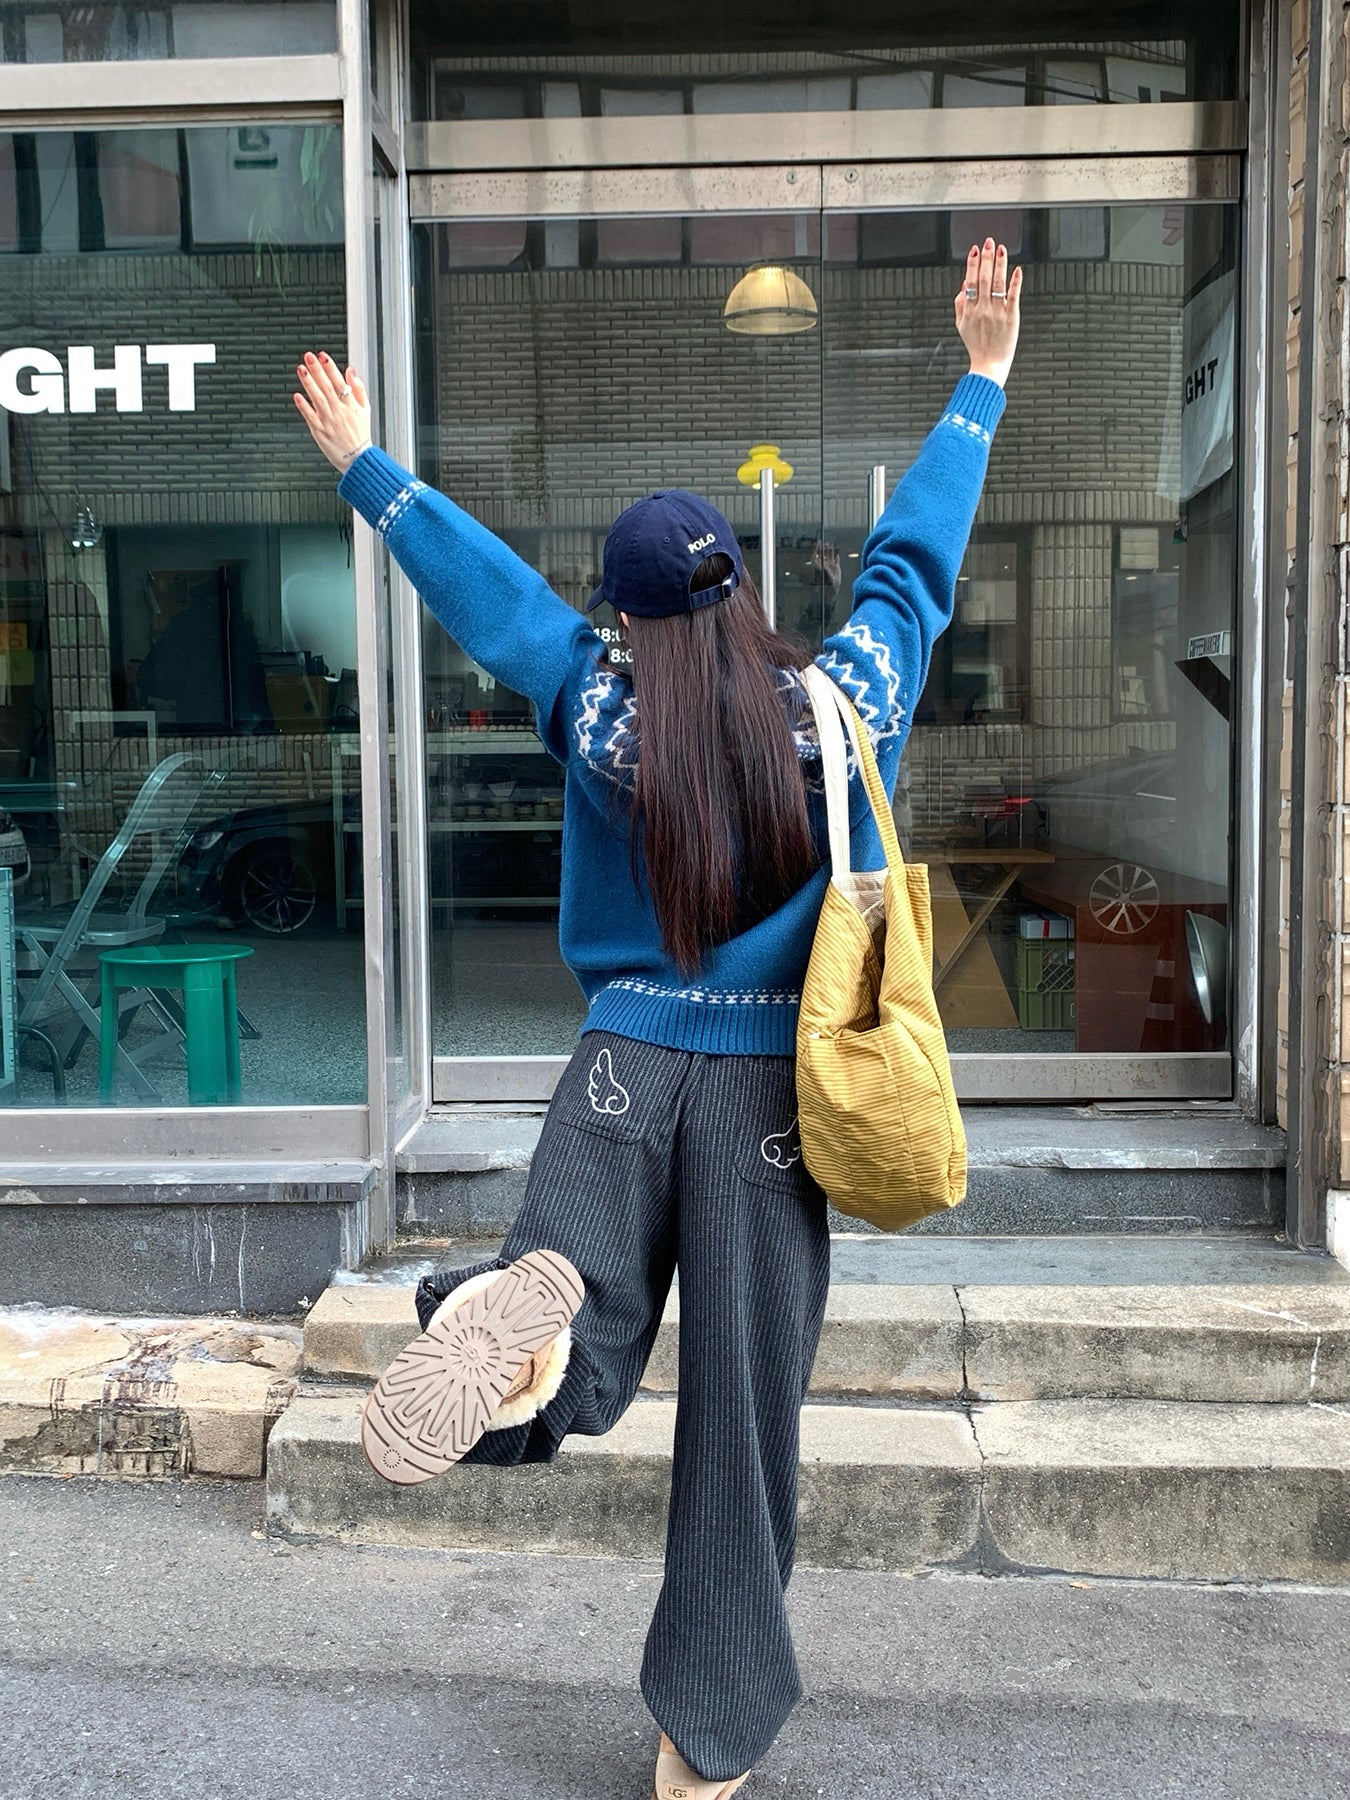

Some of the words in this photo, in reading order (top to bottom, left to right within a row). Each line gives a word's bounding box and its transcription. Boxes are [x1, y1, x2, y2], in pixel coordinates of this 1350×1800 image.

[0, 343, 217, 414] GHT
[687, 533, 716, 554] POLO
[668, 1786, 688, 1799] UGG
